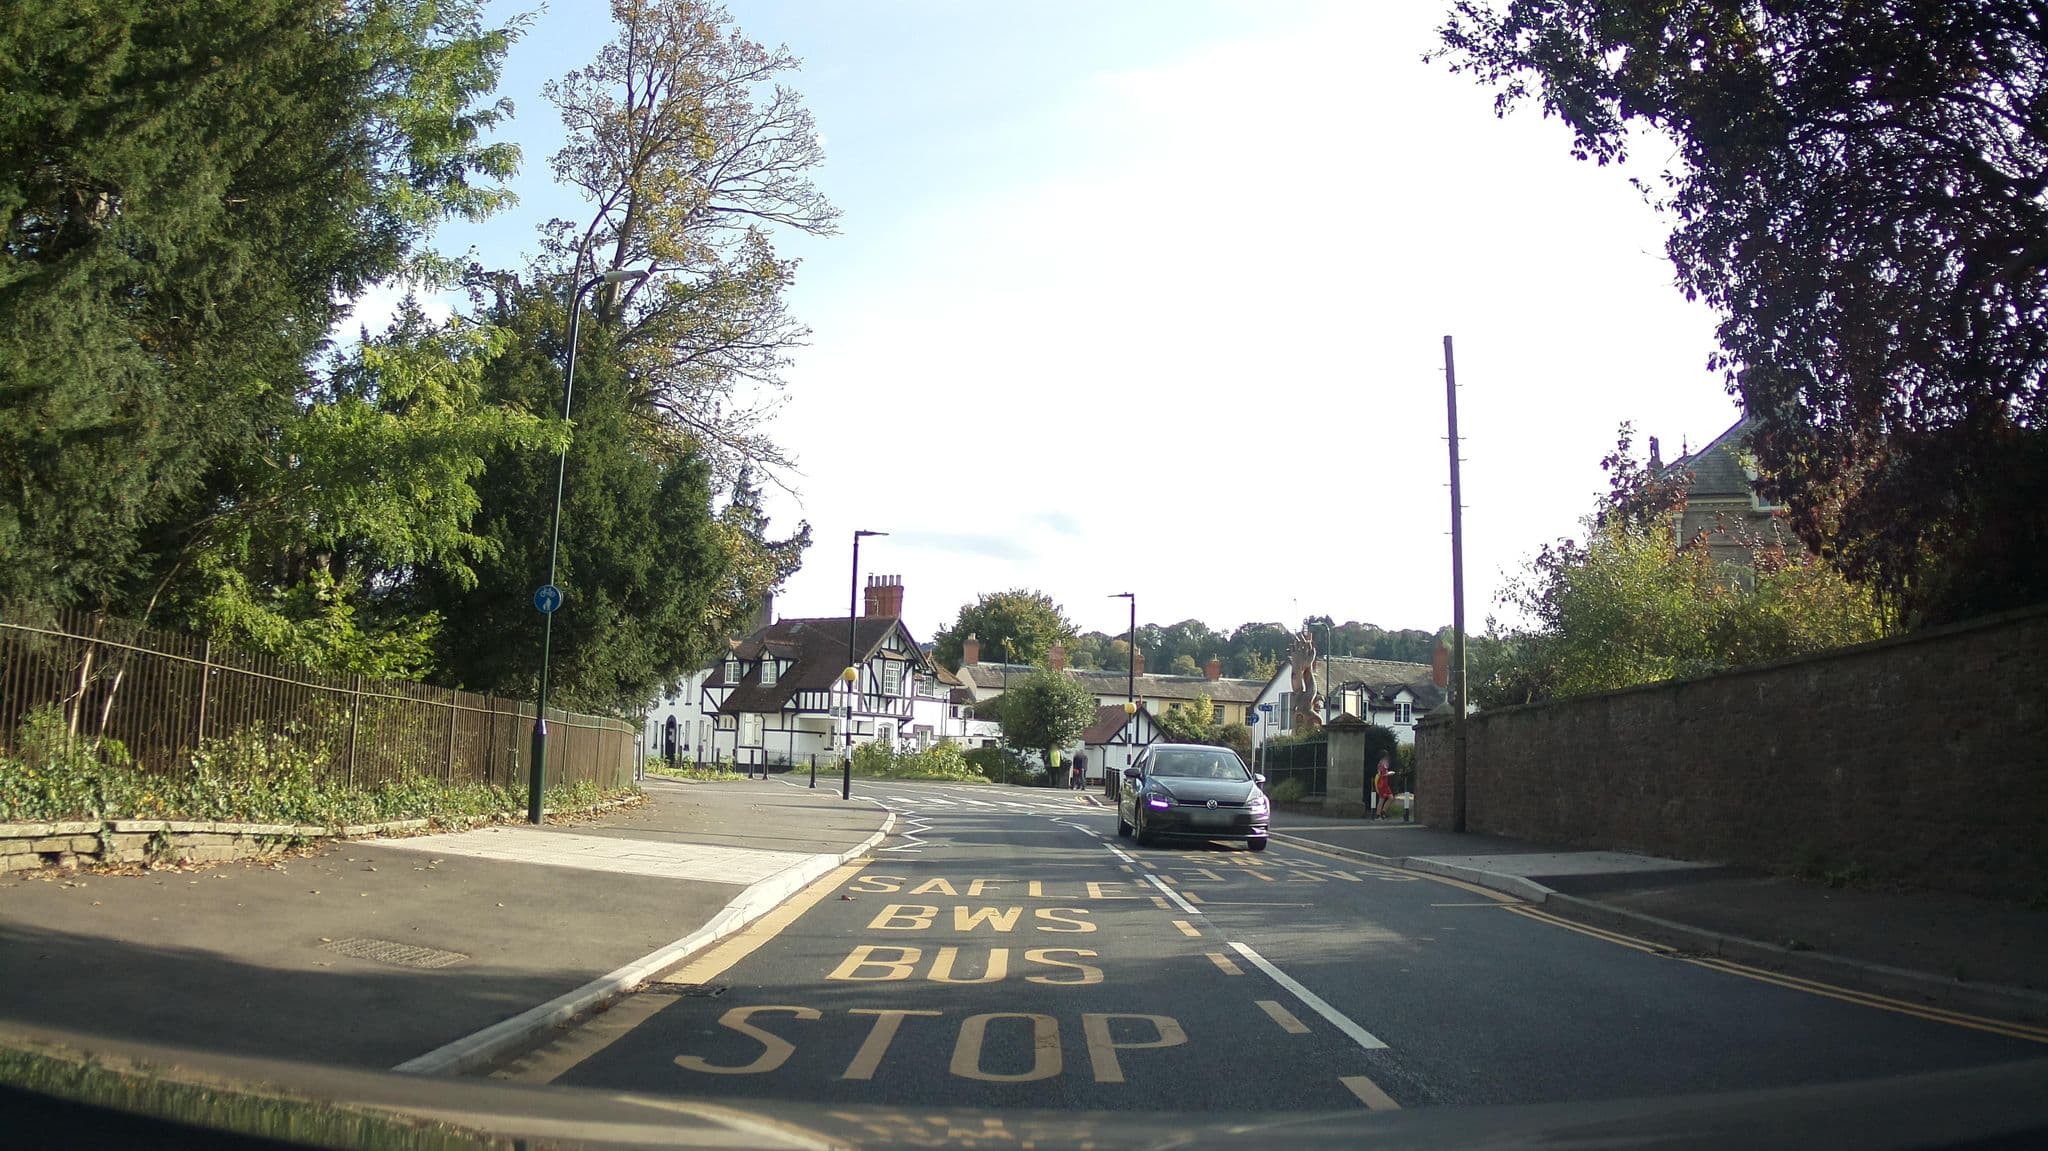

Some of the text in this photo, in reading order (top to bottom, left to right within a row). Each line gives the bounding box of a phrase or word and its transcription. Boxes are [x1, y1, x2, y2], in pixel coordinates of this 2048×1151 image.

[848, 875, 1139, 899] SAFLE
[866, 904, 1098, 933] BWS
[825, 945, 1104, 985] BUS
[672, 1005, 1189, 1083] STOP
